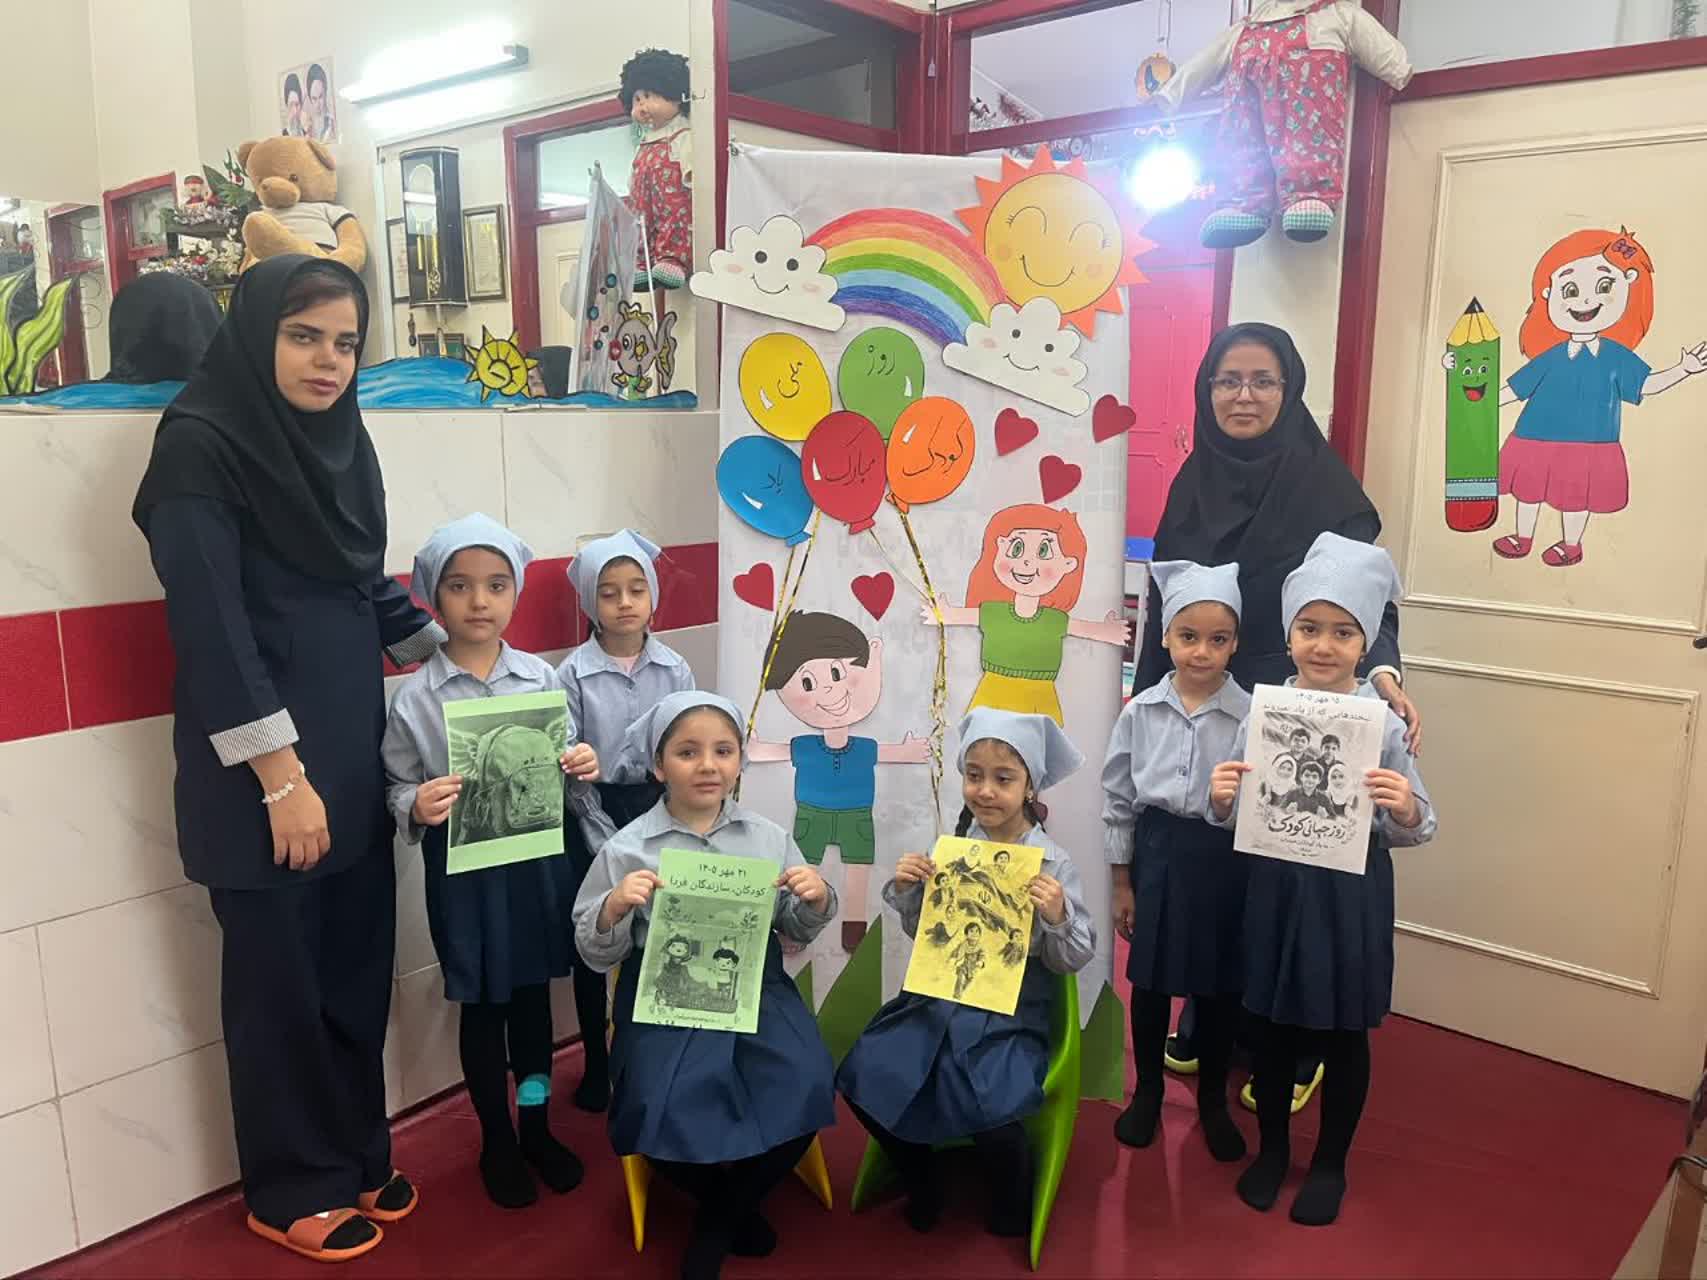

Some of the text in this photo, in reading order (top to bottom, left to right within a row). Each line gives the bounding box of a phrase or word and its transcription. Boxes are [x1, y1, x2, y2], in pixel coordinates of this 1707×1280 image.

[867, 344, 896, 377] روز
[825, 425, 876, 486] مبارک
[902, 415, 968, 476] کودک
[1268, 815, 1346, 839] روز جهانی کودک
[670, 875, 688, 889] فردا
[717, 867, 735, 878] مهر
